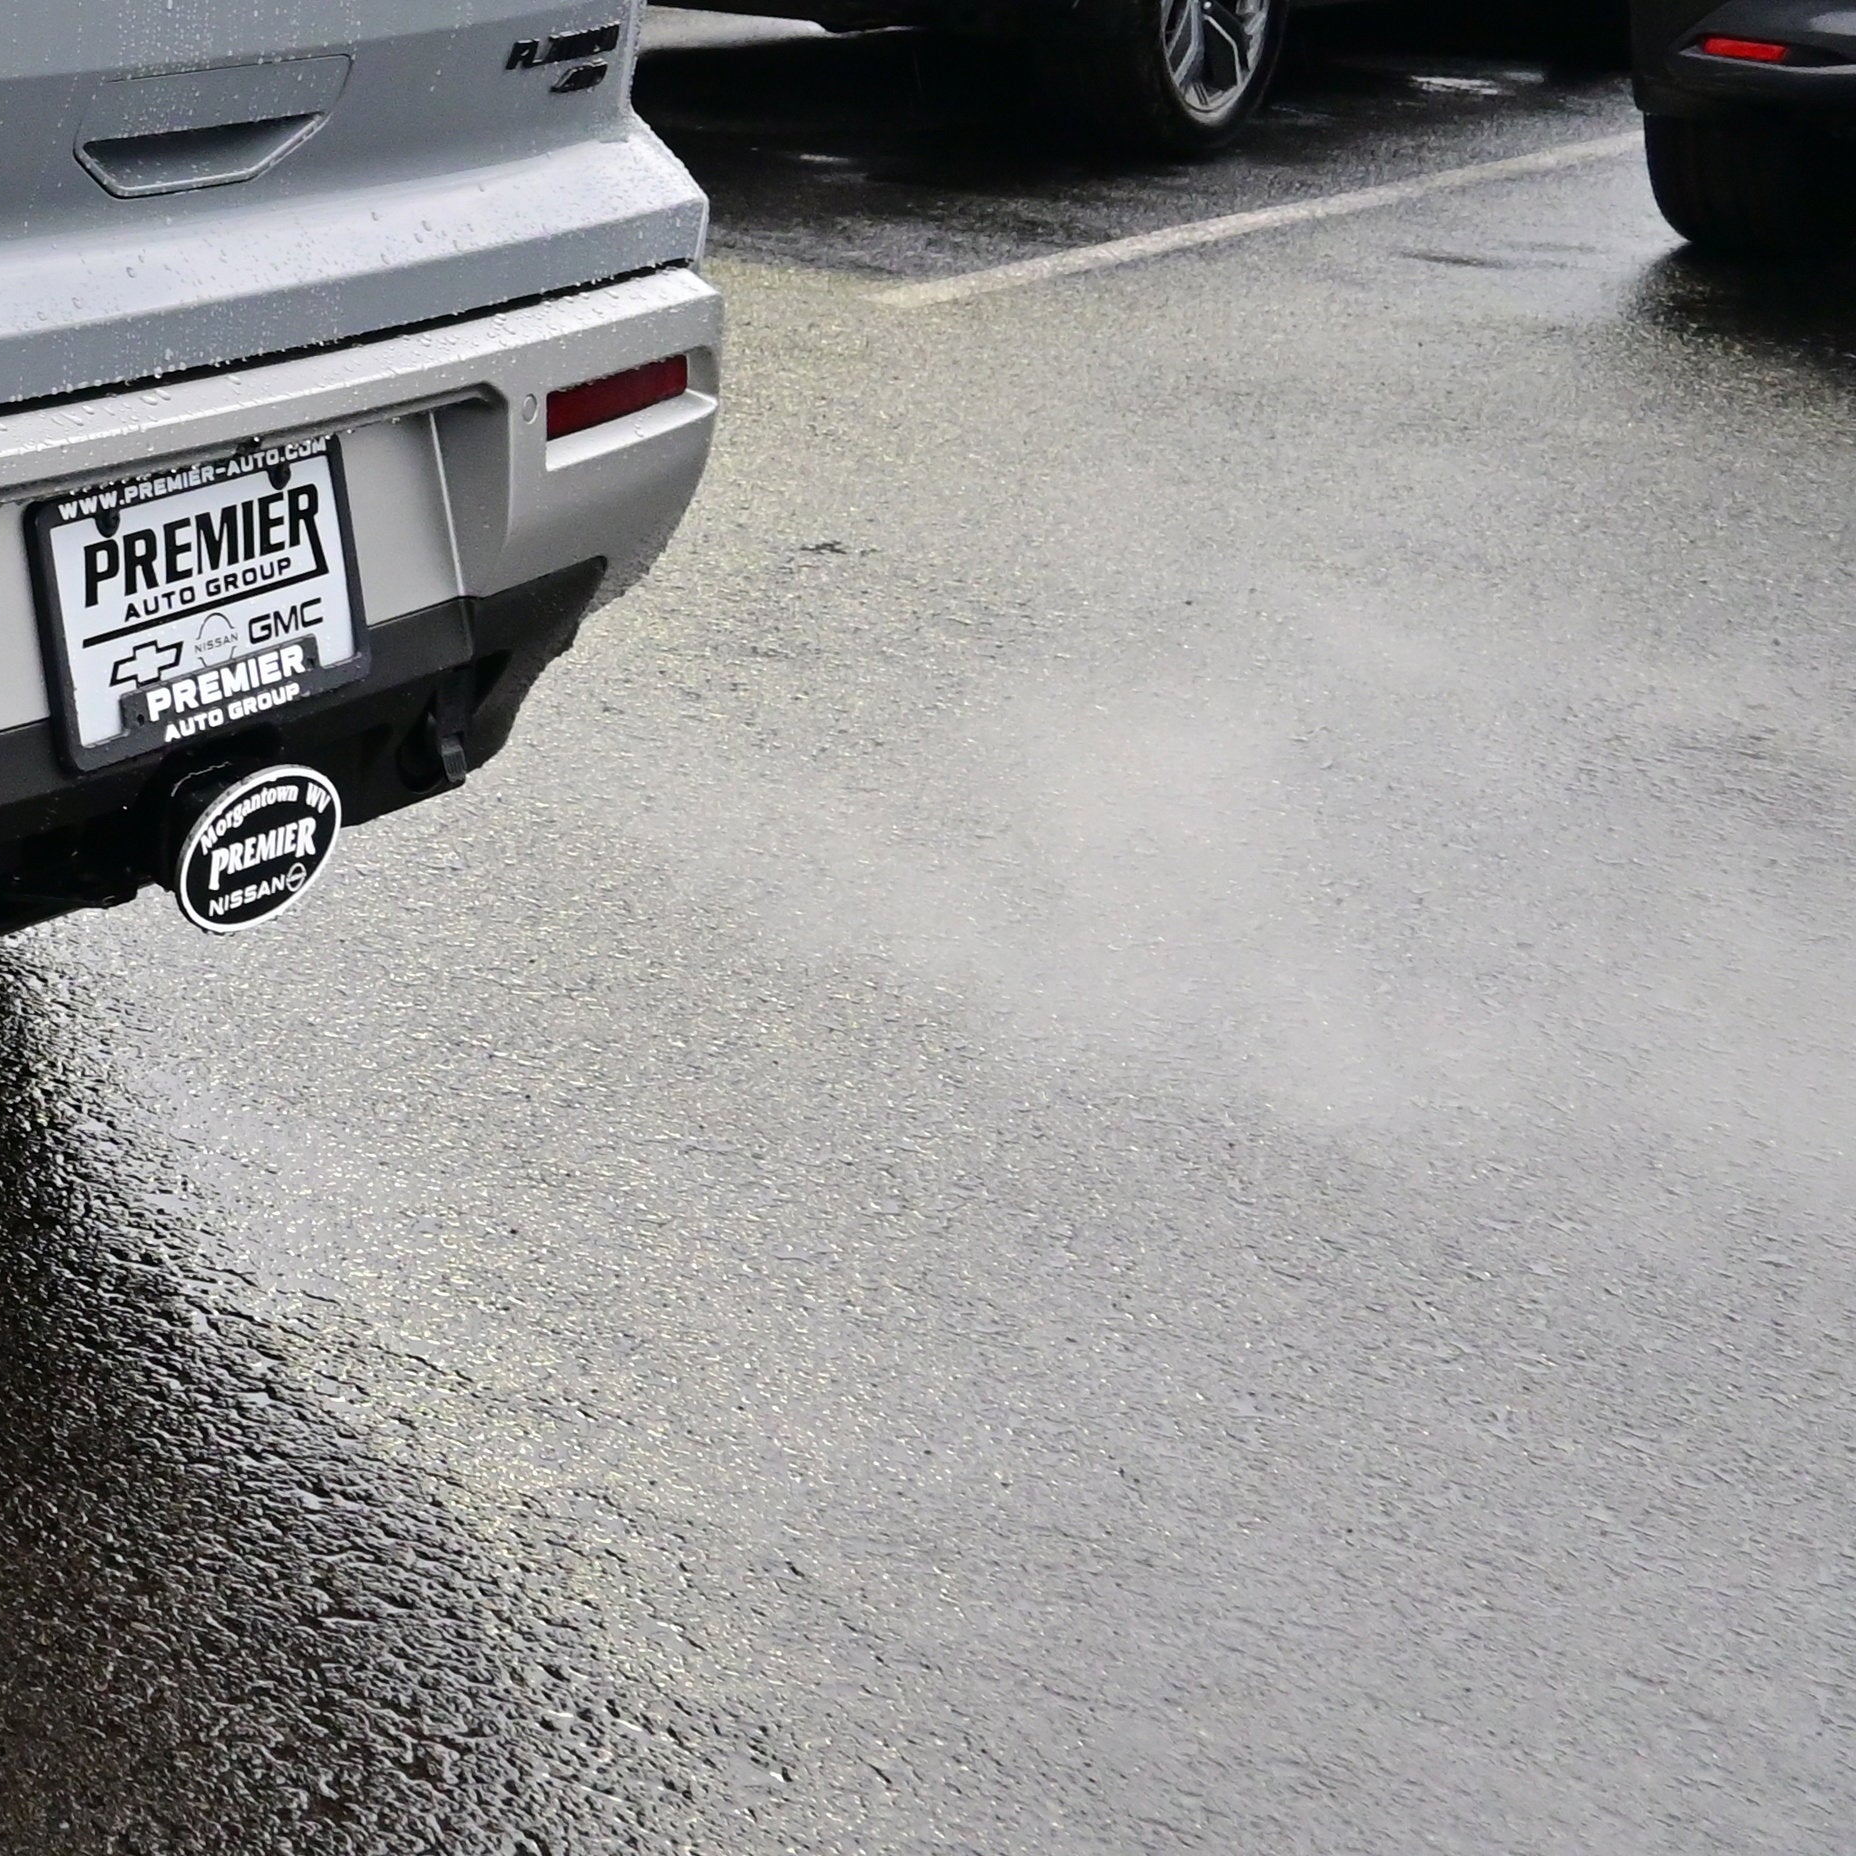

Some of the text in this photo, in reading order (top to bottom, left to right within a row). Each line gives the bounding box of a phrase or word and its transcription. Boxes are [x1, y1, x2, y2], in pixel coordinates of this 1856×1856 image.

[57, 436, 328, 521] WWW.PREMIER-AUTO.COM
[83, 482, 324, 608] PREMIER
[124, 556, 292, 622] AUTO GROUP
[194, 597, 324, 654] NISSAN GMC
[146, 644, 306, 723] PREMIER
[164, 682, 301, 743] AUTO GROUP
[199, 781, 332, 856] Morgantown WV
[207, 816, 317, 891] PREMIER
[208, 873, 286, 917] NISSAN
